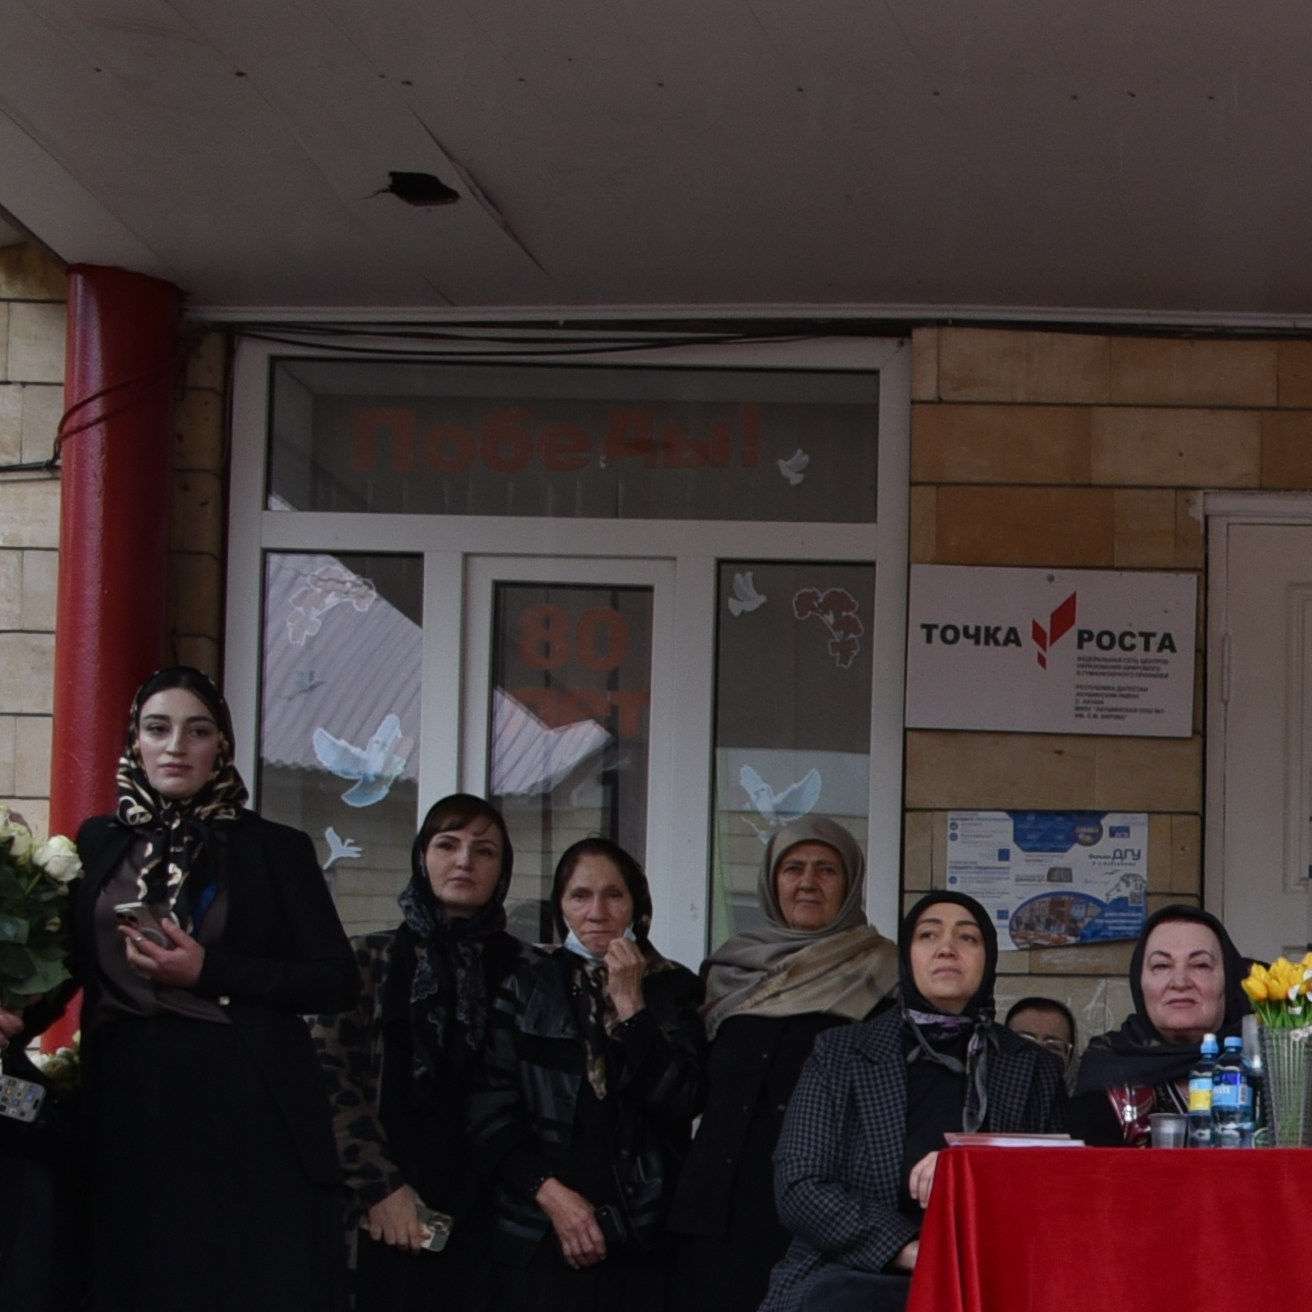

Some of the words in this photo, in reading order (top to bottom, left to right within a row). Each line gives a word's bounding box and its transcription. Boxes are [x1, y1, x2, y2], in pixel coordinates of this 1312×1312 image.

[519, 604, 630, 672] 80
[920, 623, 1022, 647] ТОЧКА
[1076, 629, 1178, 653] РОСТА
[1112, 848, 1142, 861] ДГУ
